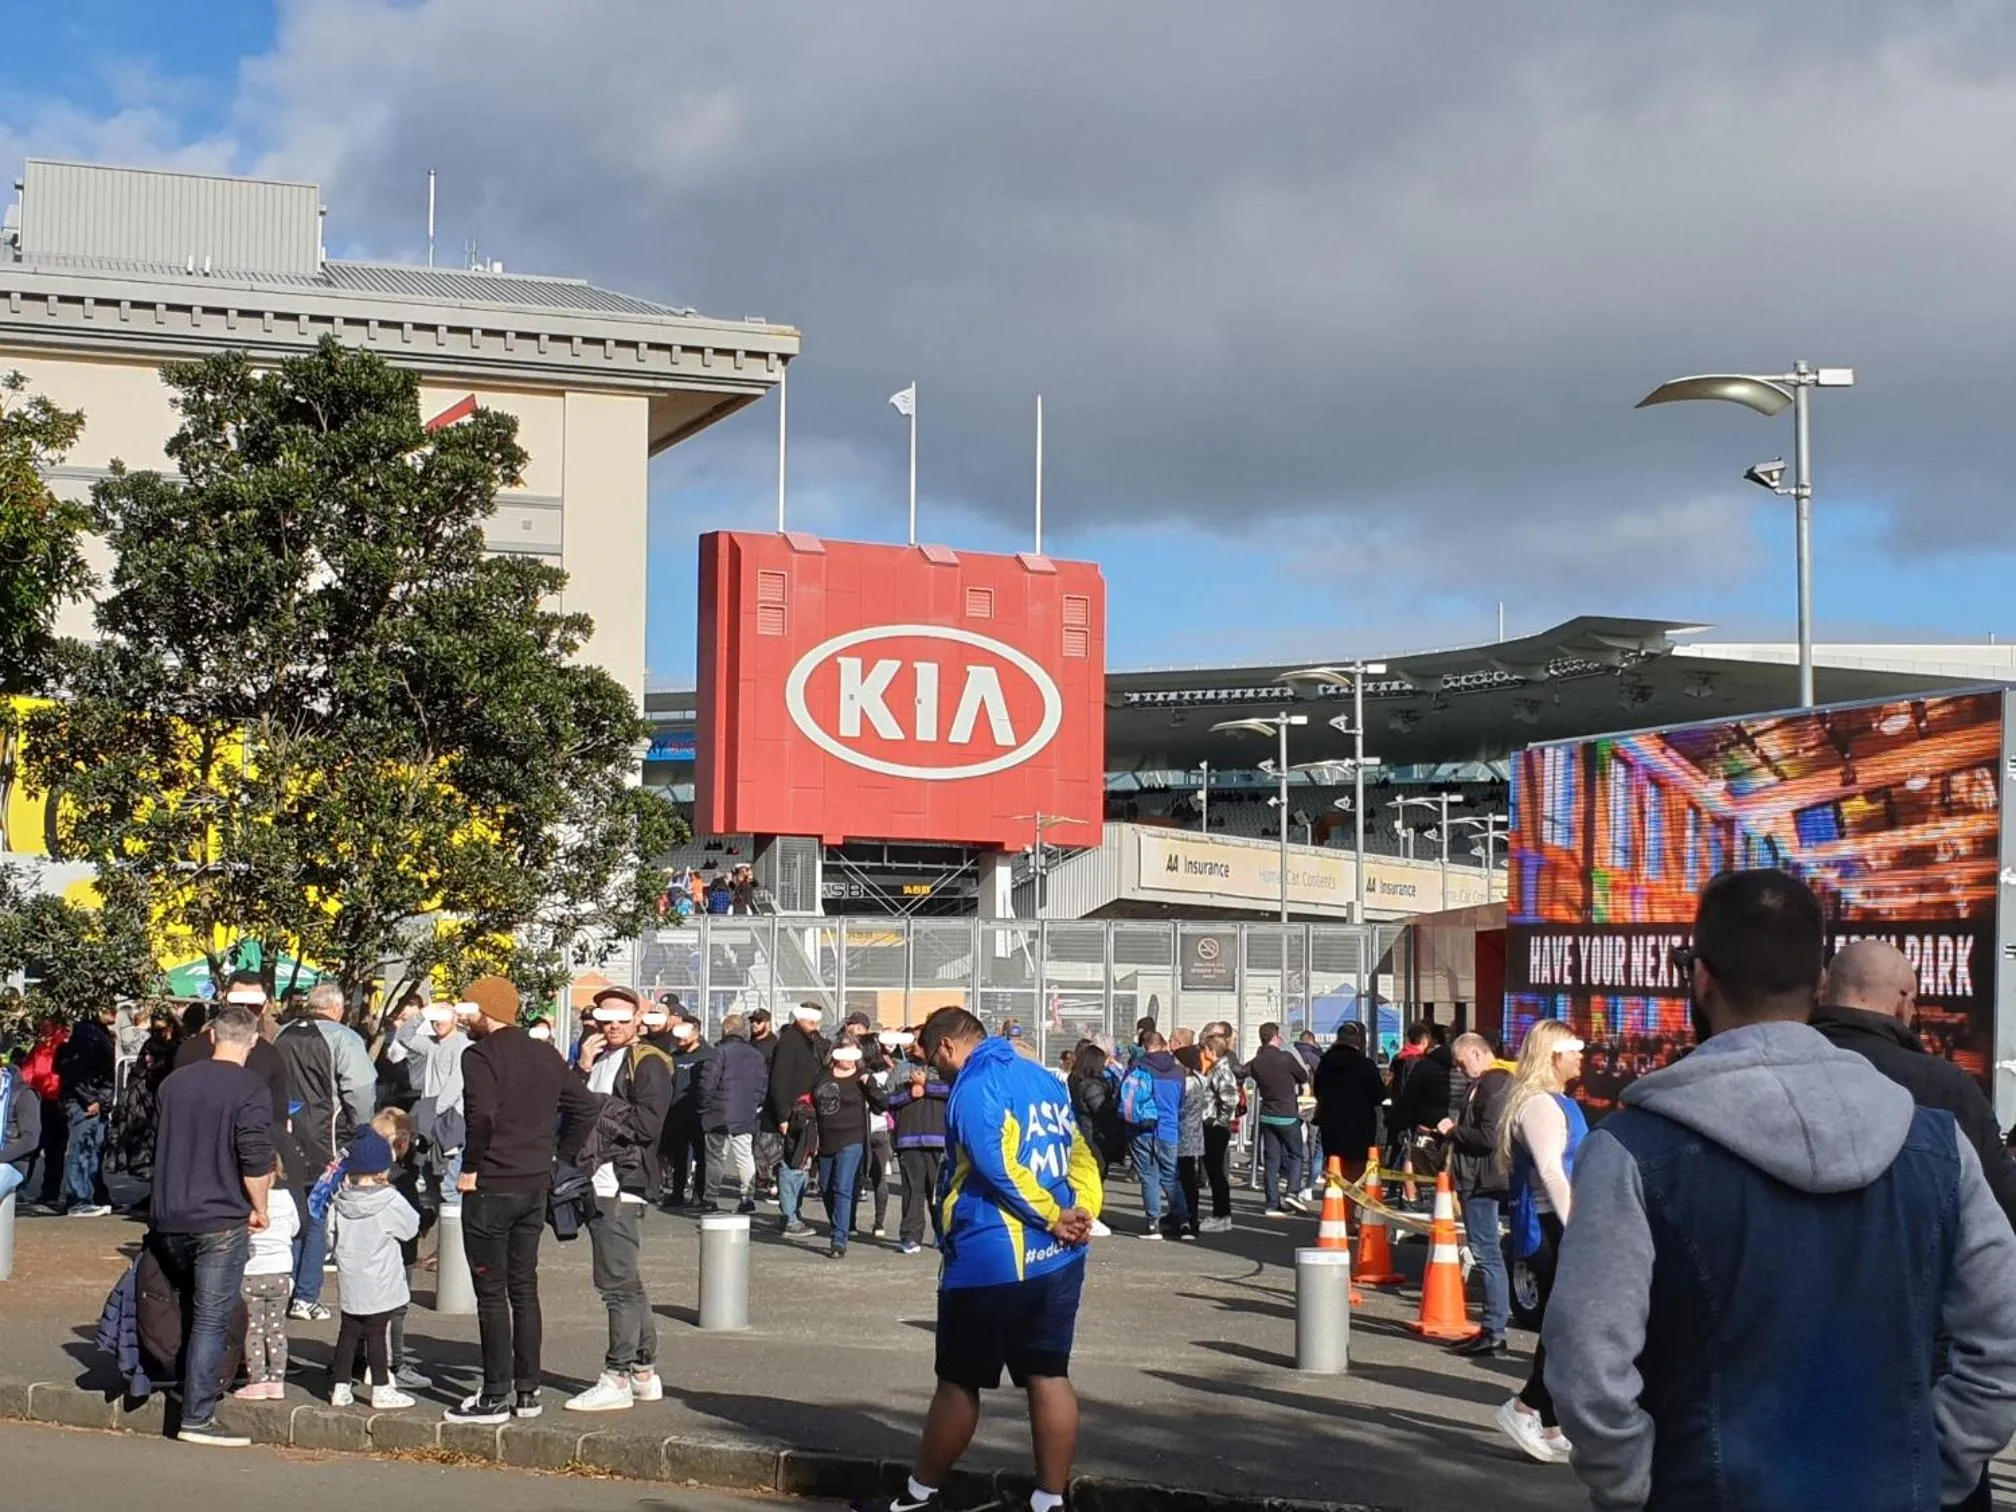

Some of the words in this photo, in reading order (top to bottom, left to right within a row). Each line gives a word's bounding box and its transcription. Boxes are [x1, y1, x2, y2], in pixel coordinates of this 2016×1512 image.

[836, 656, 1017, 746] KIA
[1166, 854, 1179, 873] AA
[1184, 856, 1230, 878] Insurance
[1366, 876, 1376, 893] AA
[1379, 877, 1416, 898] Insurance
[1529, 935, 1573, 985] HAVE
[1578, 935, 1627, 986] YOUR
[1630, 934, 1683, 988] NEXT
[1904, 934, 1974, 997] PARK
[1025, 1100, 1073, 1142] ASK
